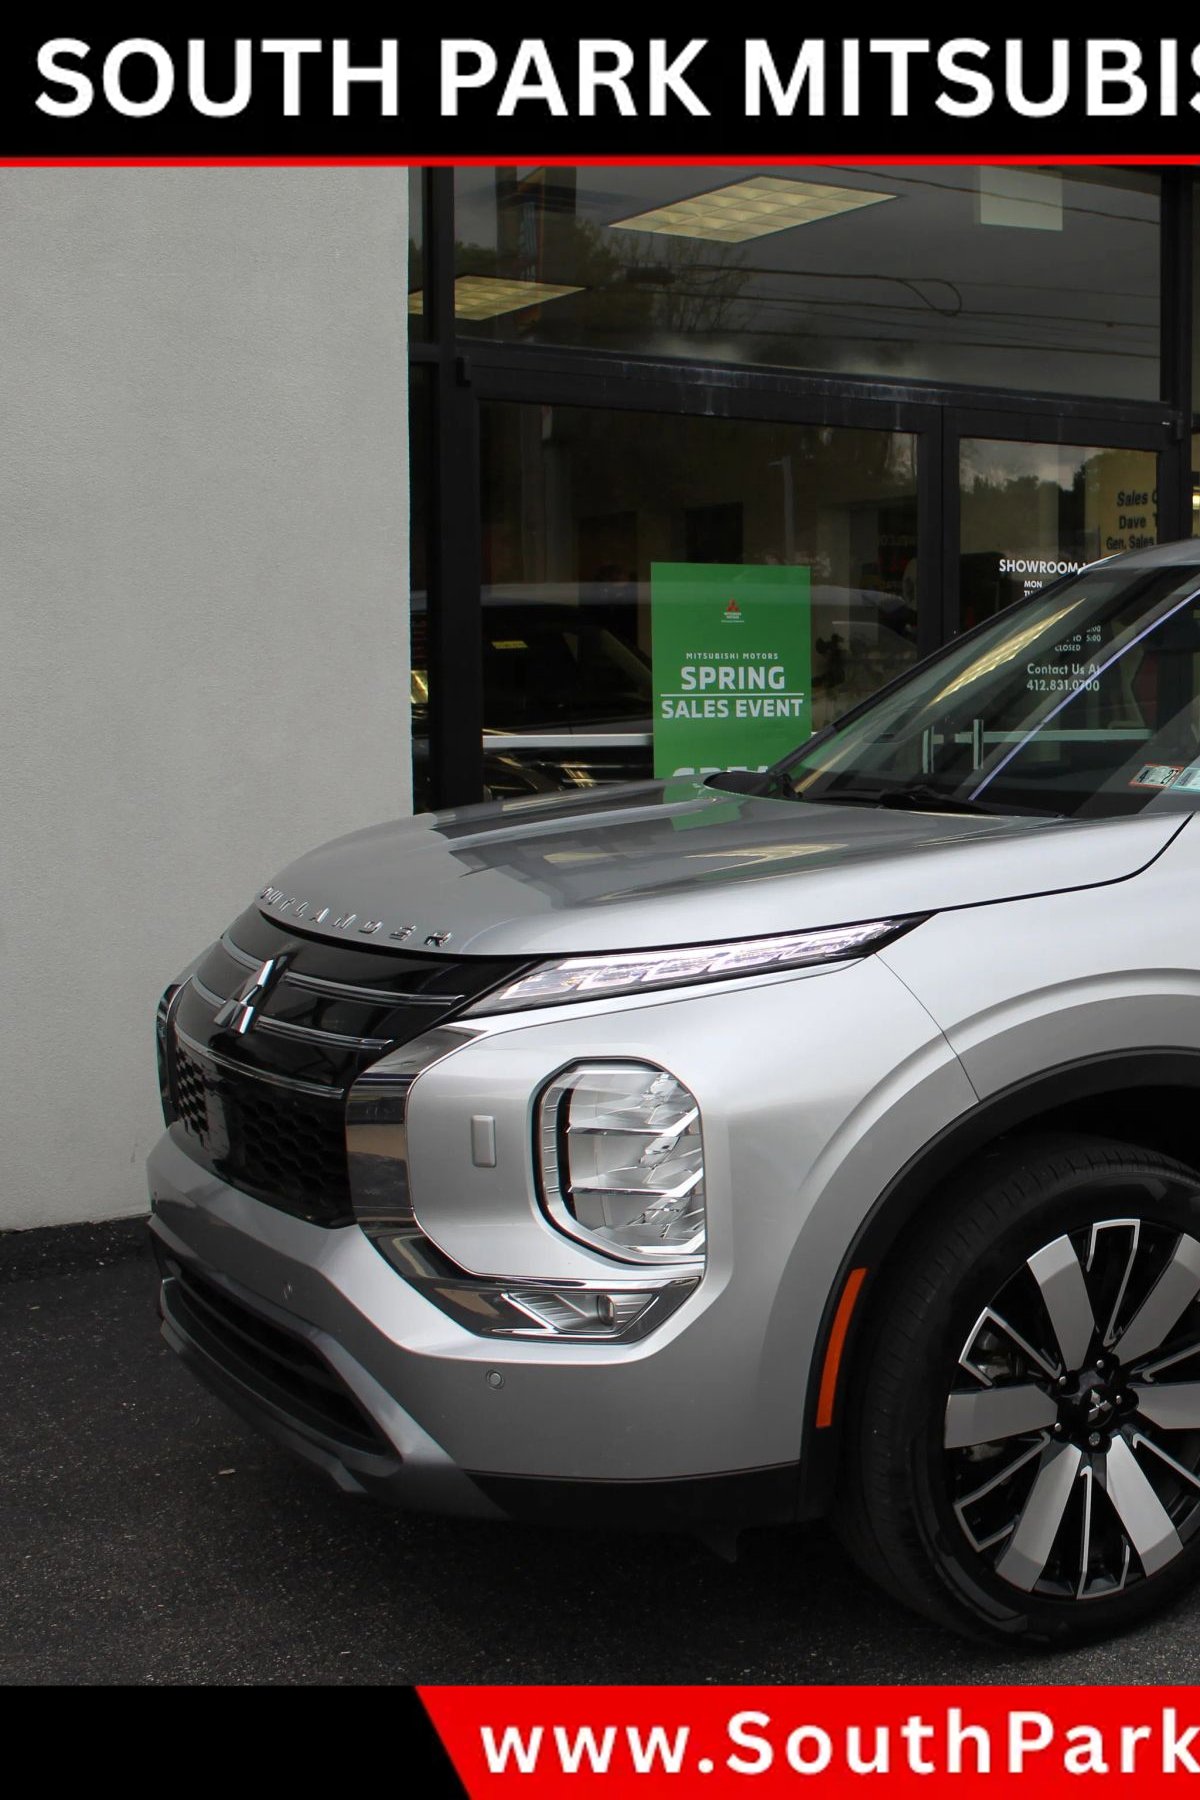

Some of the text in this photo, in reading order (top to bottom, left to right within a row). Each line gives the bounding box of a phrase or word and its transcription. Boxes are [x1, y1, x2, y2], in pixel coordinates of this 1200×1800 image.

[1116, 490, 1148, 507] Sales
[1119, 515, 1146, 529] Dave
[999, 559, 1078, 575] SHOWROOM
[1054, 644, 1081, 652] CLOSED
[686, 652, 778, 660] MITSUBISHI MOTORS
[1027, 663, 1068, 675] Contact
[1071, 663, 1085, 675] Us
[680, 666, 785, 690] SPRING
[661, 699, 803, 719] SALES EVENT
